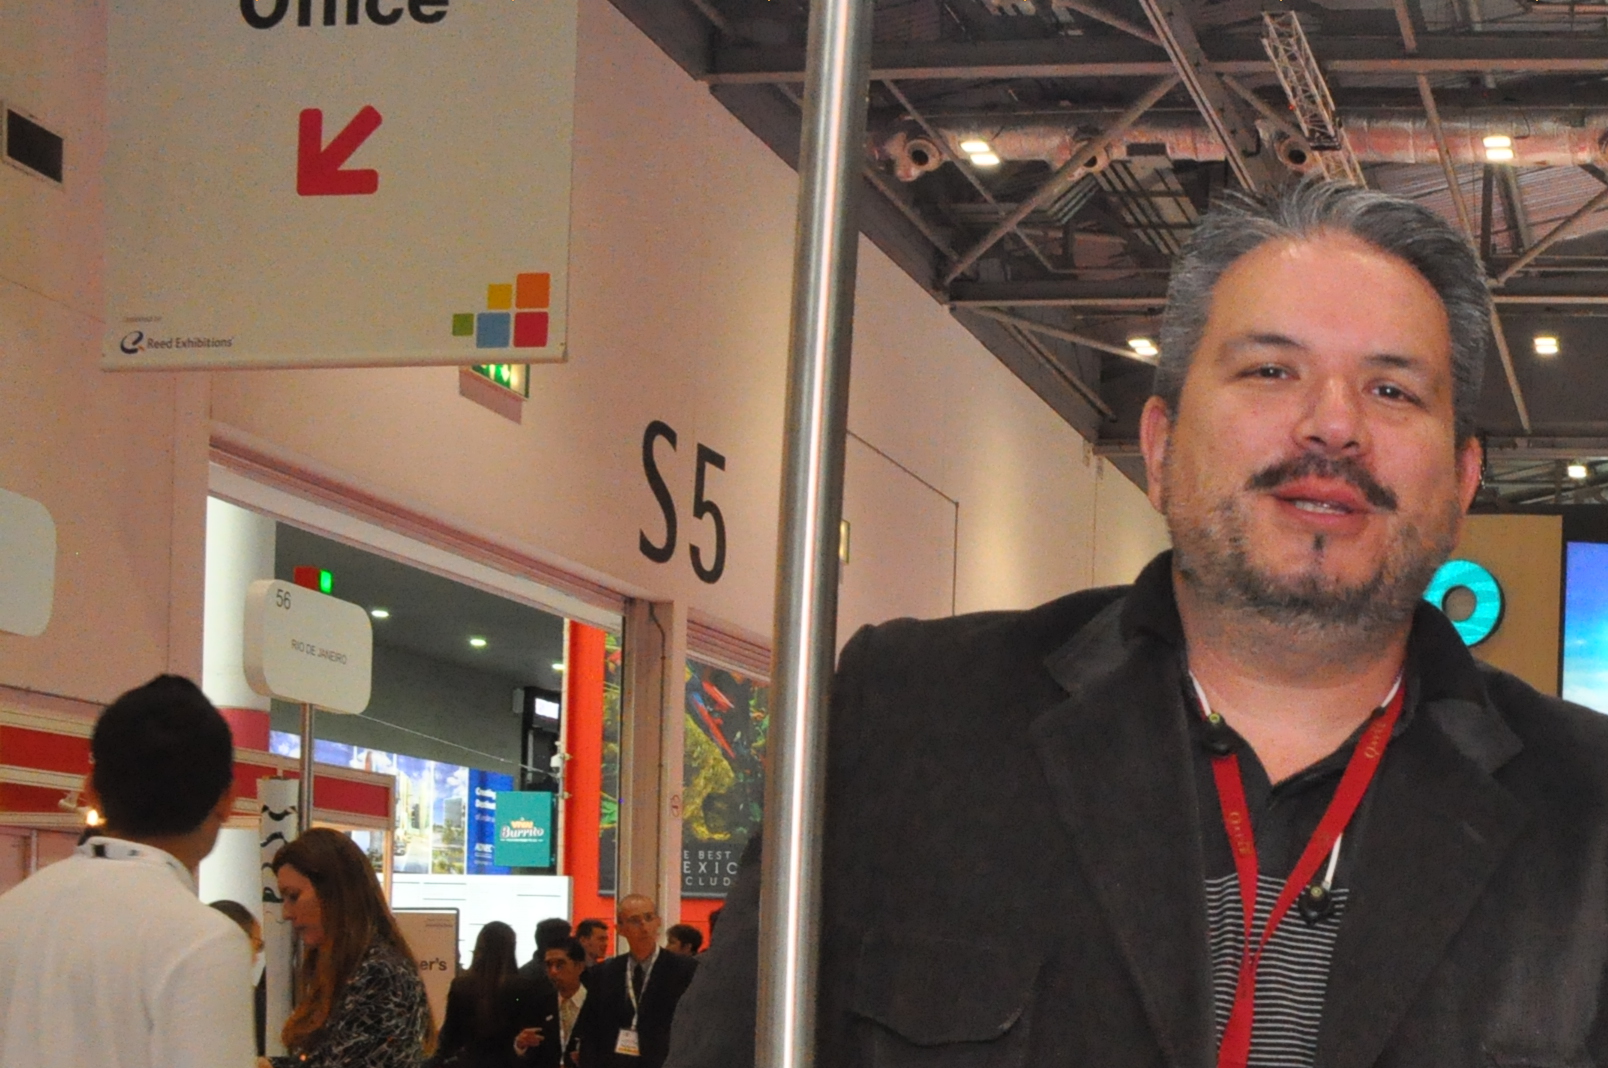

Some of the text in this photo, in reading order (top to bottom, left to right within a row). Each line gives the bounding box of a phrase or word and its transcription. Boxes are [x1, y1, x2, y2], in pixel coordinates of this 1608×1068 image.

[147, 336, 233, 349] Reed Exhibitions
[639, 420, 726, 584] S5
[276, 589, 291, 610] 56
[291, 639, 348, 665] RIO DE JANEIRO
[501, 826, 545, 839] Burrito
[698, 850, 732, 860] BEST
[683, 861, 738, 875] EXIC
[685, 876, 731, 887] CLUD
[420, 957, 447, 971] er's
